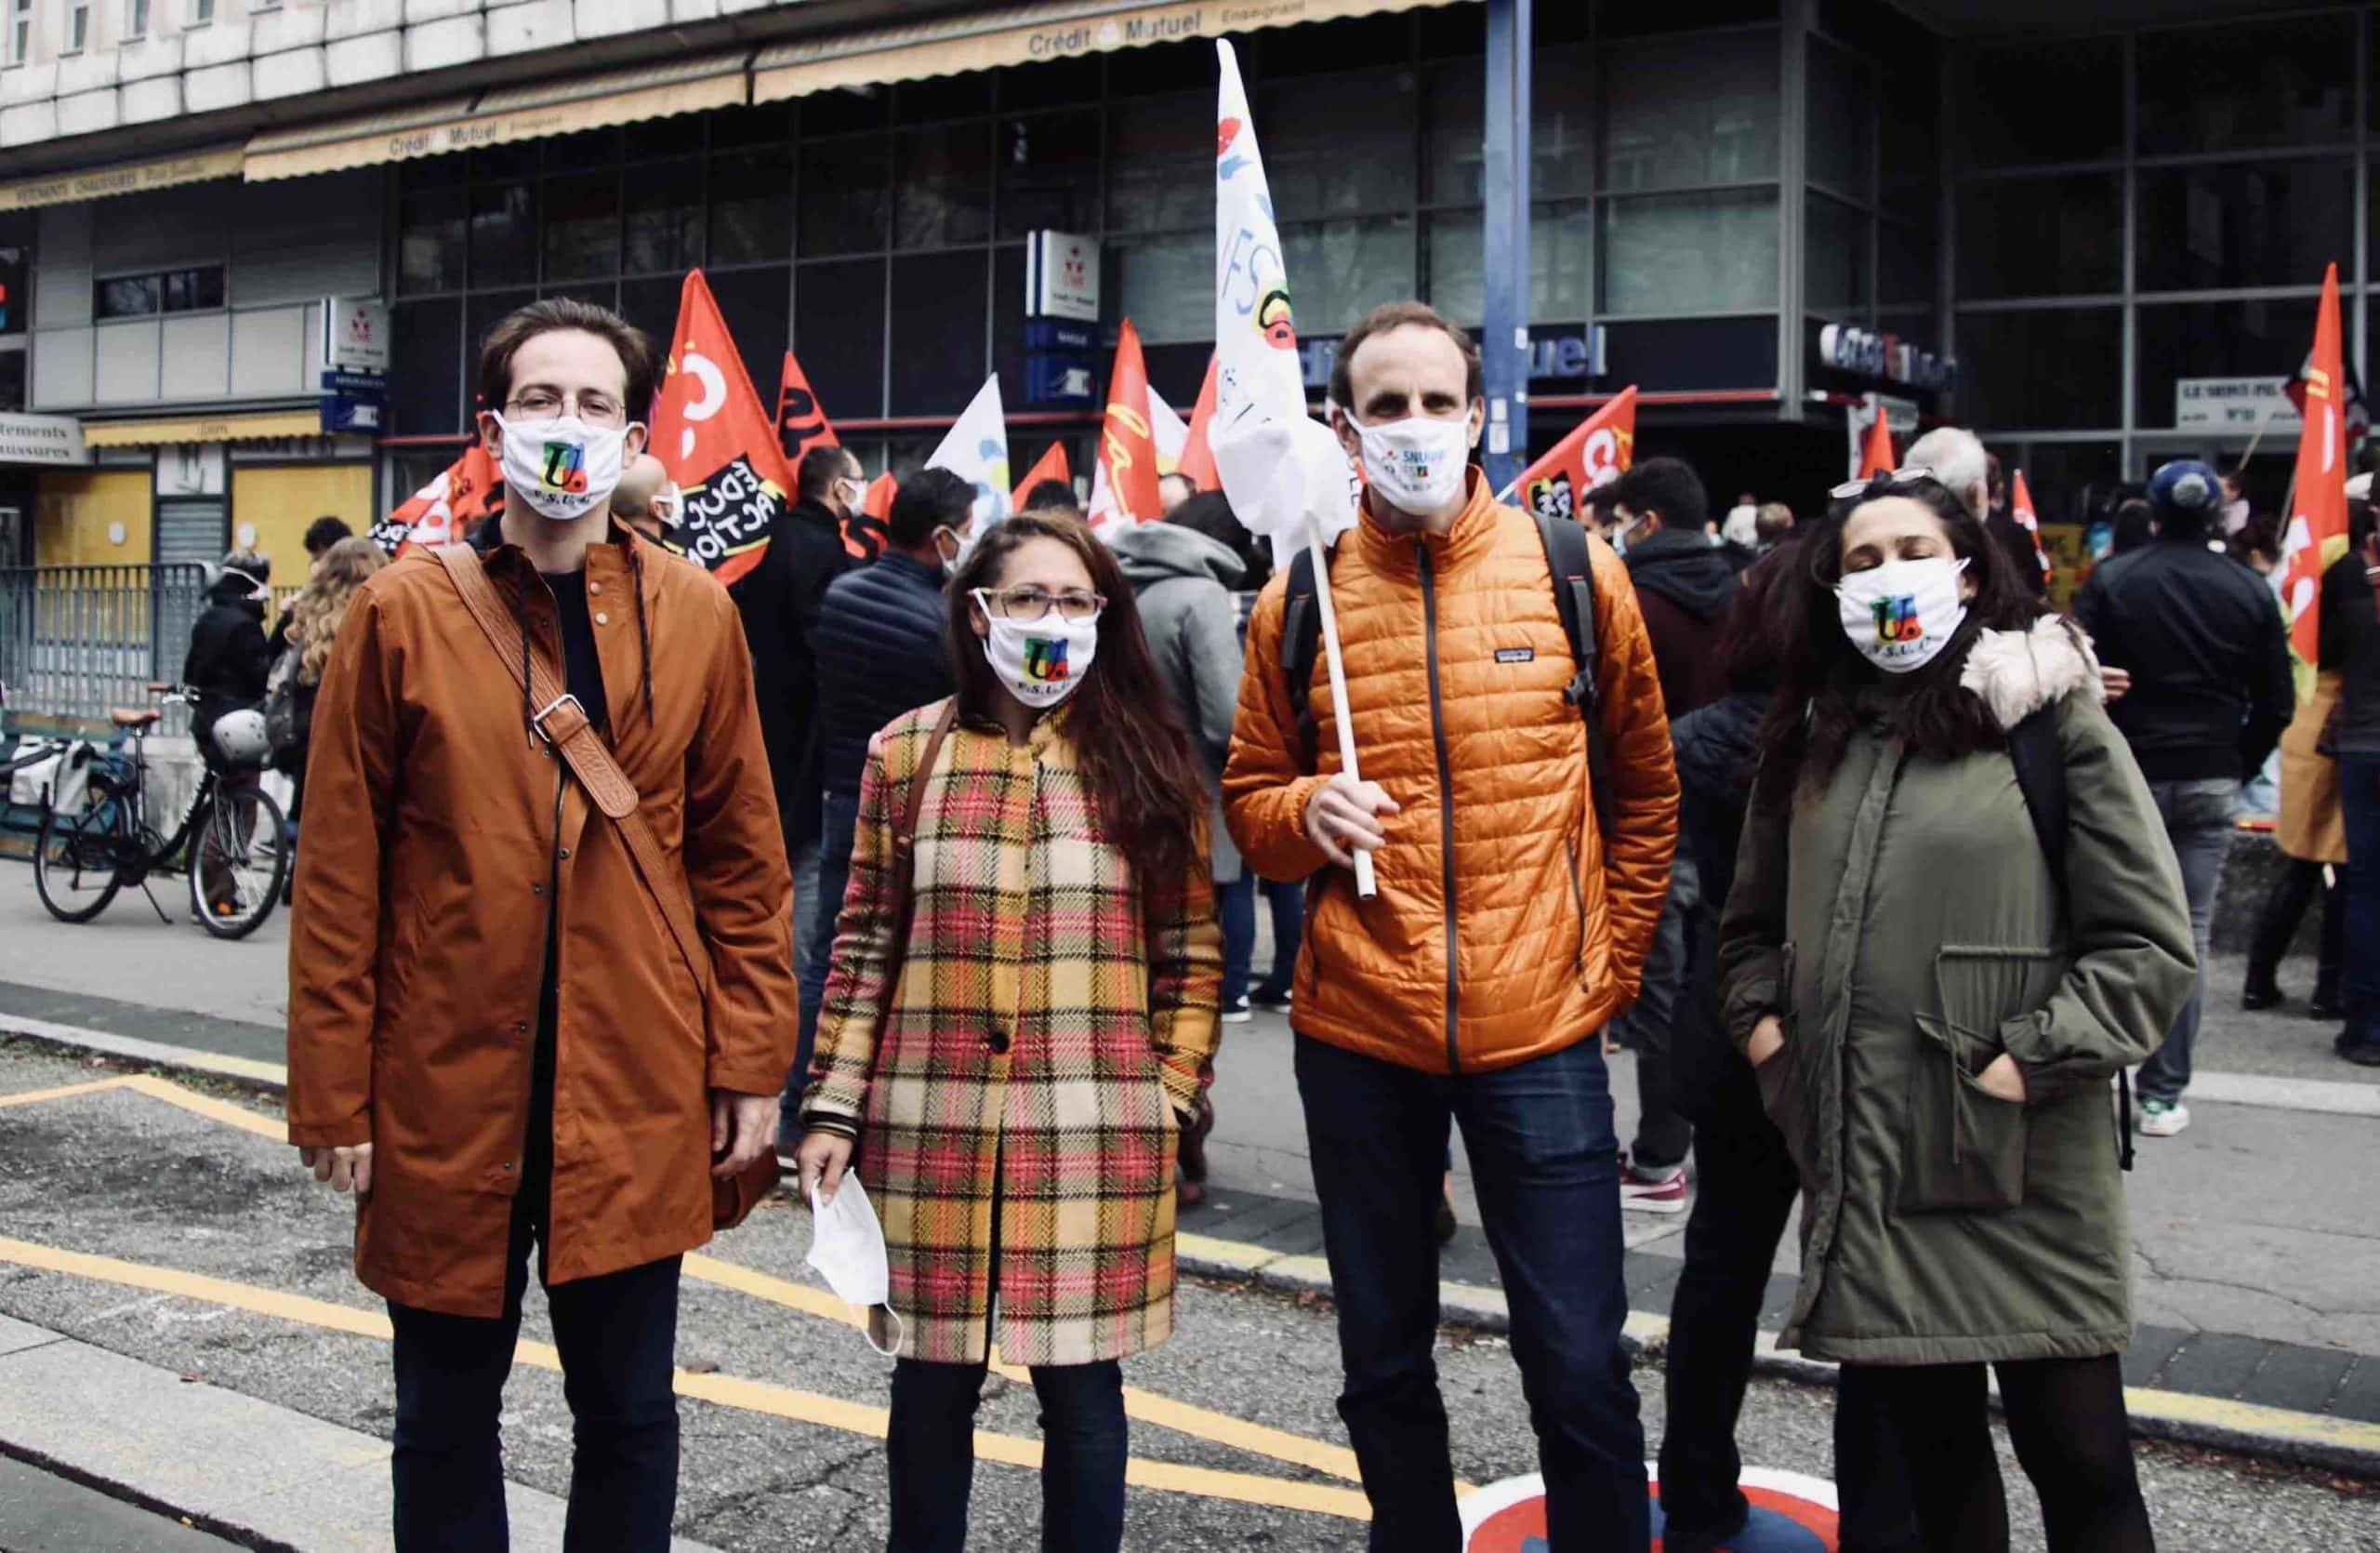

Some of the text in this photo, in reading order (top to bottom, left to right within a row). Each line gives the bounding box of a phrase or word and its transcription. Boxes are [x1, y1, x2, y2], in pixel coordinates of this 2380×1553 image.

[1028, 29, 1091, 54] Crédit
[1126, 10, 1201, 39] Mutuel
[389, 134, 430, 156] Crédit
[449, 123, 497, 143] Mutuel
